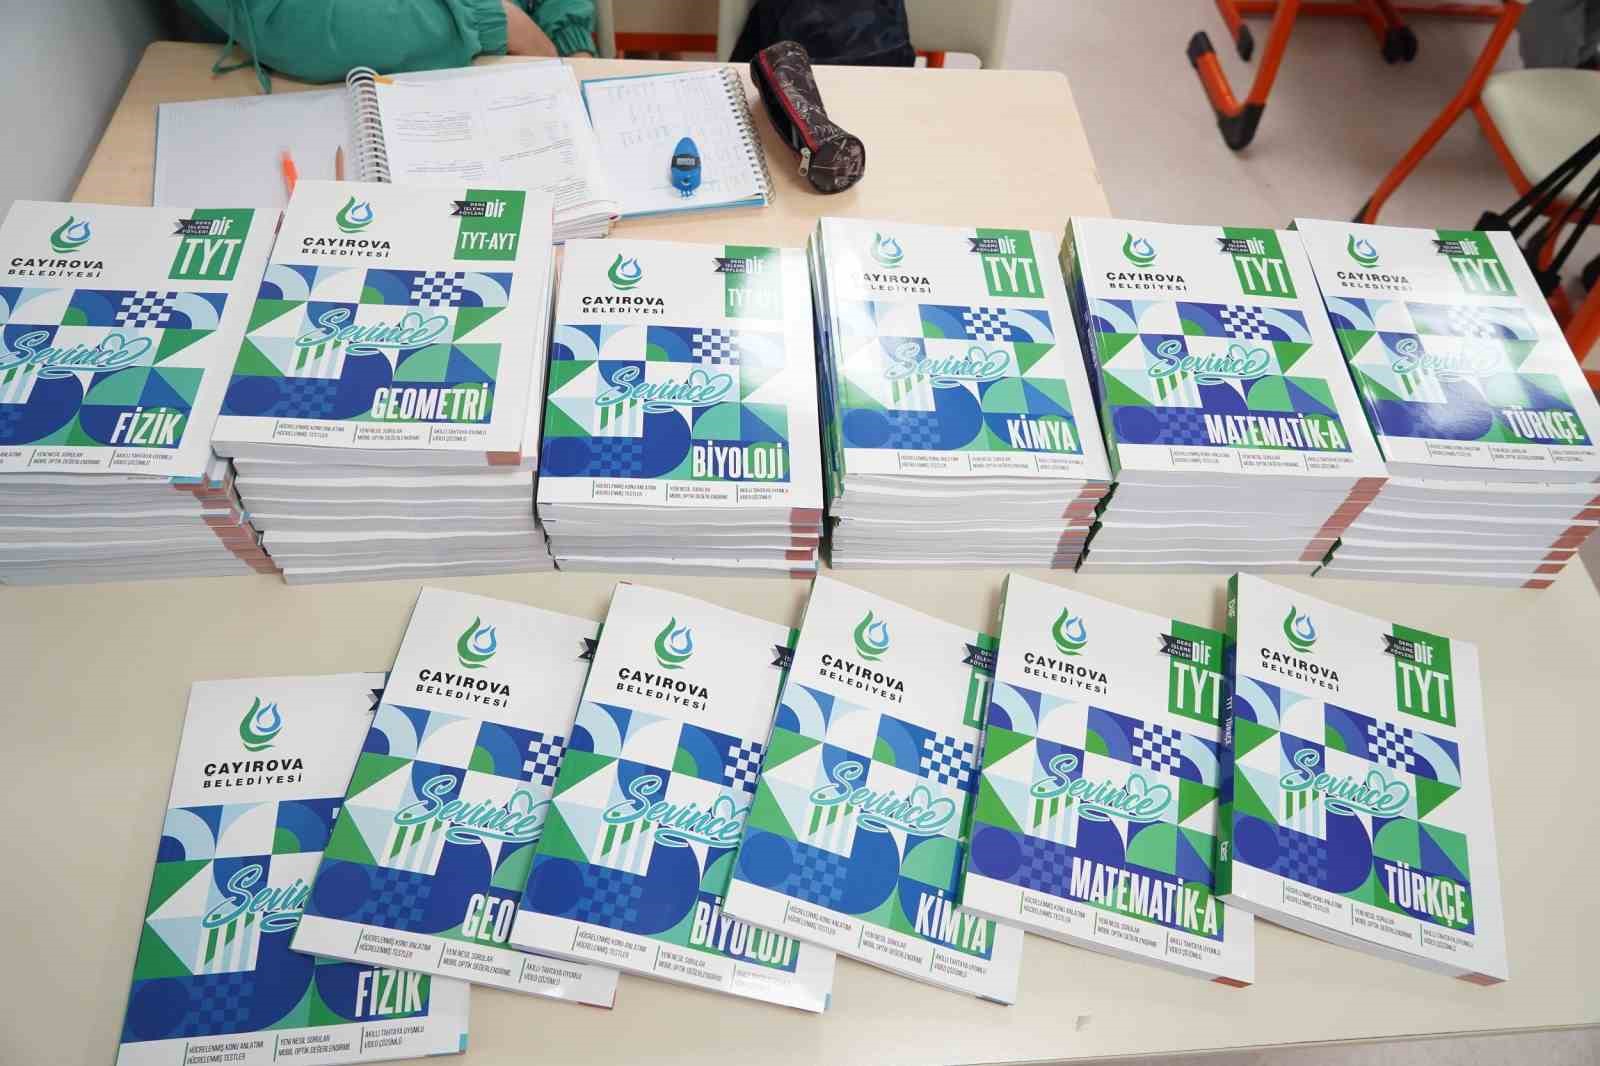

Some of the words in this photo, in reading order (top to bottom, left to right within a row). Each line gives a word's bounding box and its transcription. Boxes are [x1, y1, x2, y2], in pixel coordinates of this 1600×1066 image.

[209, 216, 234, 236] DİF
[485, 198, 507, 218] DİF
[179, 237, 242, 276] TYT
[461, 231, 517, 251] TYT-AYT
[998, 235, 1016, 254] DİF
[985, 256, 1037, 294] TYT
[1235, 256, 1290, 294] TYT
[1451, 257, 1511, 293] TYT
[295, 307, 449, 357] Sevince
[884, 341, 1012, 389] Sevince
[1147, 339, 1271, 387] Sevince
[371, 382, 489, 421] GEOMETRİ
[595, 364, 733, 413] Sevince
[110, 405, 183, 445] FİZİK
[1007, 413, 1078, 452] KİMYA
[1203, 411, 1348, 450] MATEMATİK-A
[1503, 405, 1586, 445] TÜRKÇE
[692, 440, 785, 480] BİYOLOJİ
[1023, 651, 1109, 685] ÇAYIROVA
[1192, 640, 1212, 665] DİF
[1260, 647, 1340, 683] ÇAYIROVA
[1414, 641, 1434, 666] DİF
[418, 668, 511, 698] ÇAYIROVA
[618, 667, 710, 700] ÇAYIROVA
[818, 667, 903, 704] BELEDİYESİ
[821, 653, 905, 693] ÇAYIROVA
[1023, 666, 1108, 695] BELEDİYESİ
[1174, 661, 1225, 719] TYT
[1260, 660, 1341, 693] BELEDİYESİ
[1398, 661, 1449, 718] TYT
[416, 684, 508, 709] BELEDİYESİ
[616, 682, 707, 712] BELEDİYESİ
[202, 773, 303, 789] BELEDİYESİ
[203, 757, 304, 777] ÇAYIROVA
[1280, 748, 1410, 819] Sevince
[809, 760, 957, 836] Sevince
[1030, 753, 1173, 822] Sevince
[602, 774, 750, 848] Sevince
[1069, 857, 1219, 936] MATEMATİK-A
[1384, 861, 1469, 930] TÜRKÇE
[914, 888, 987, 954] KİMYA
